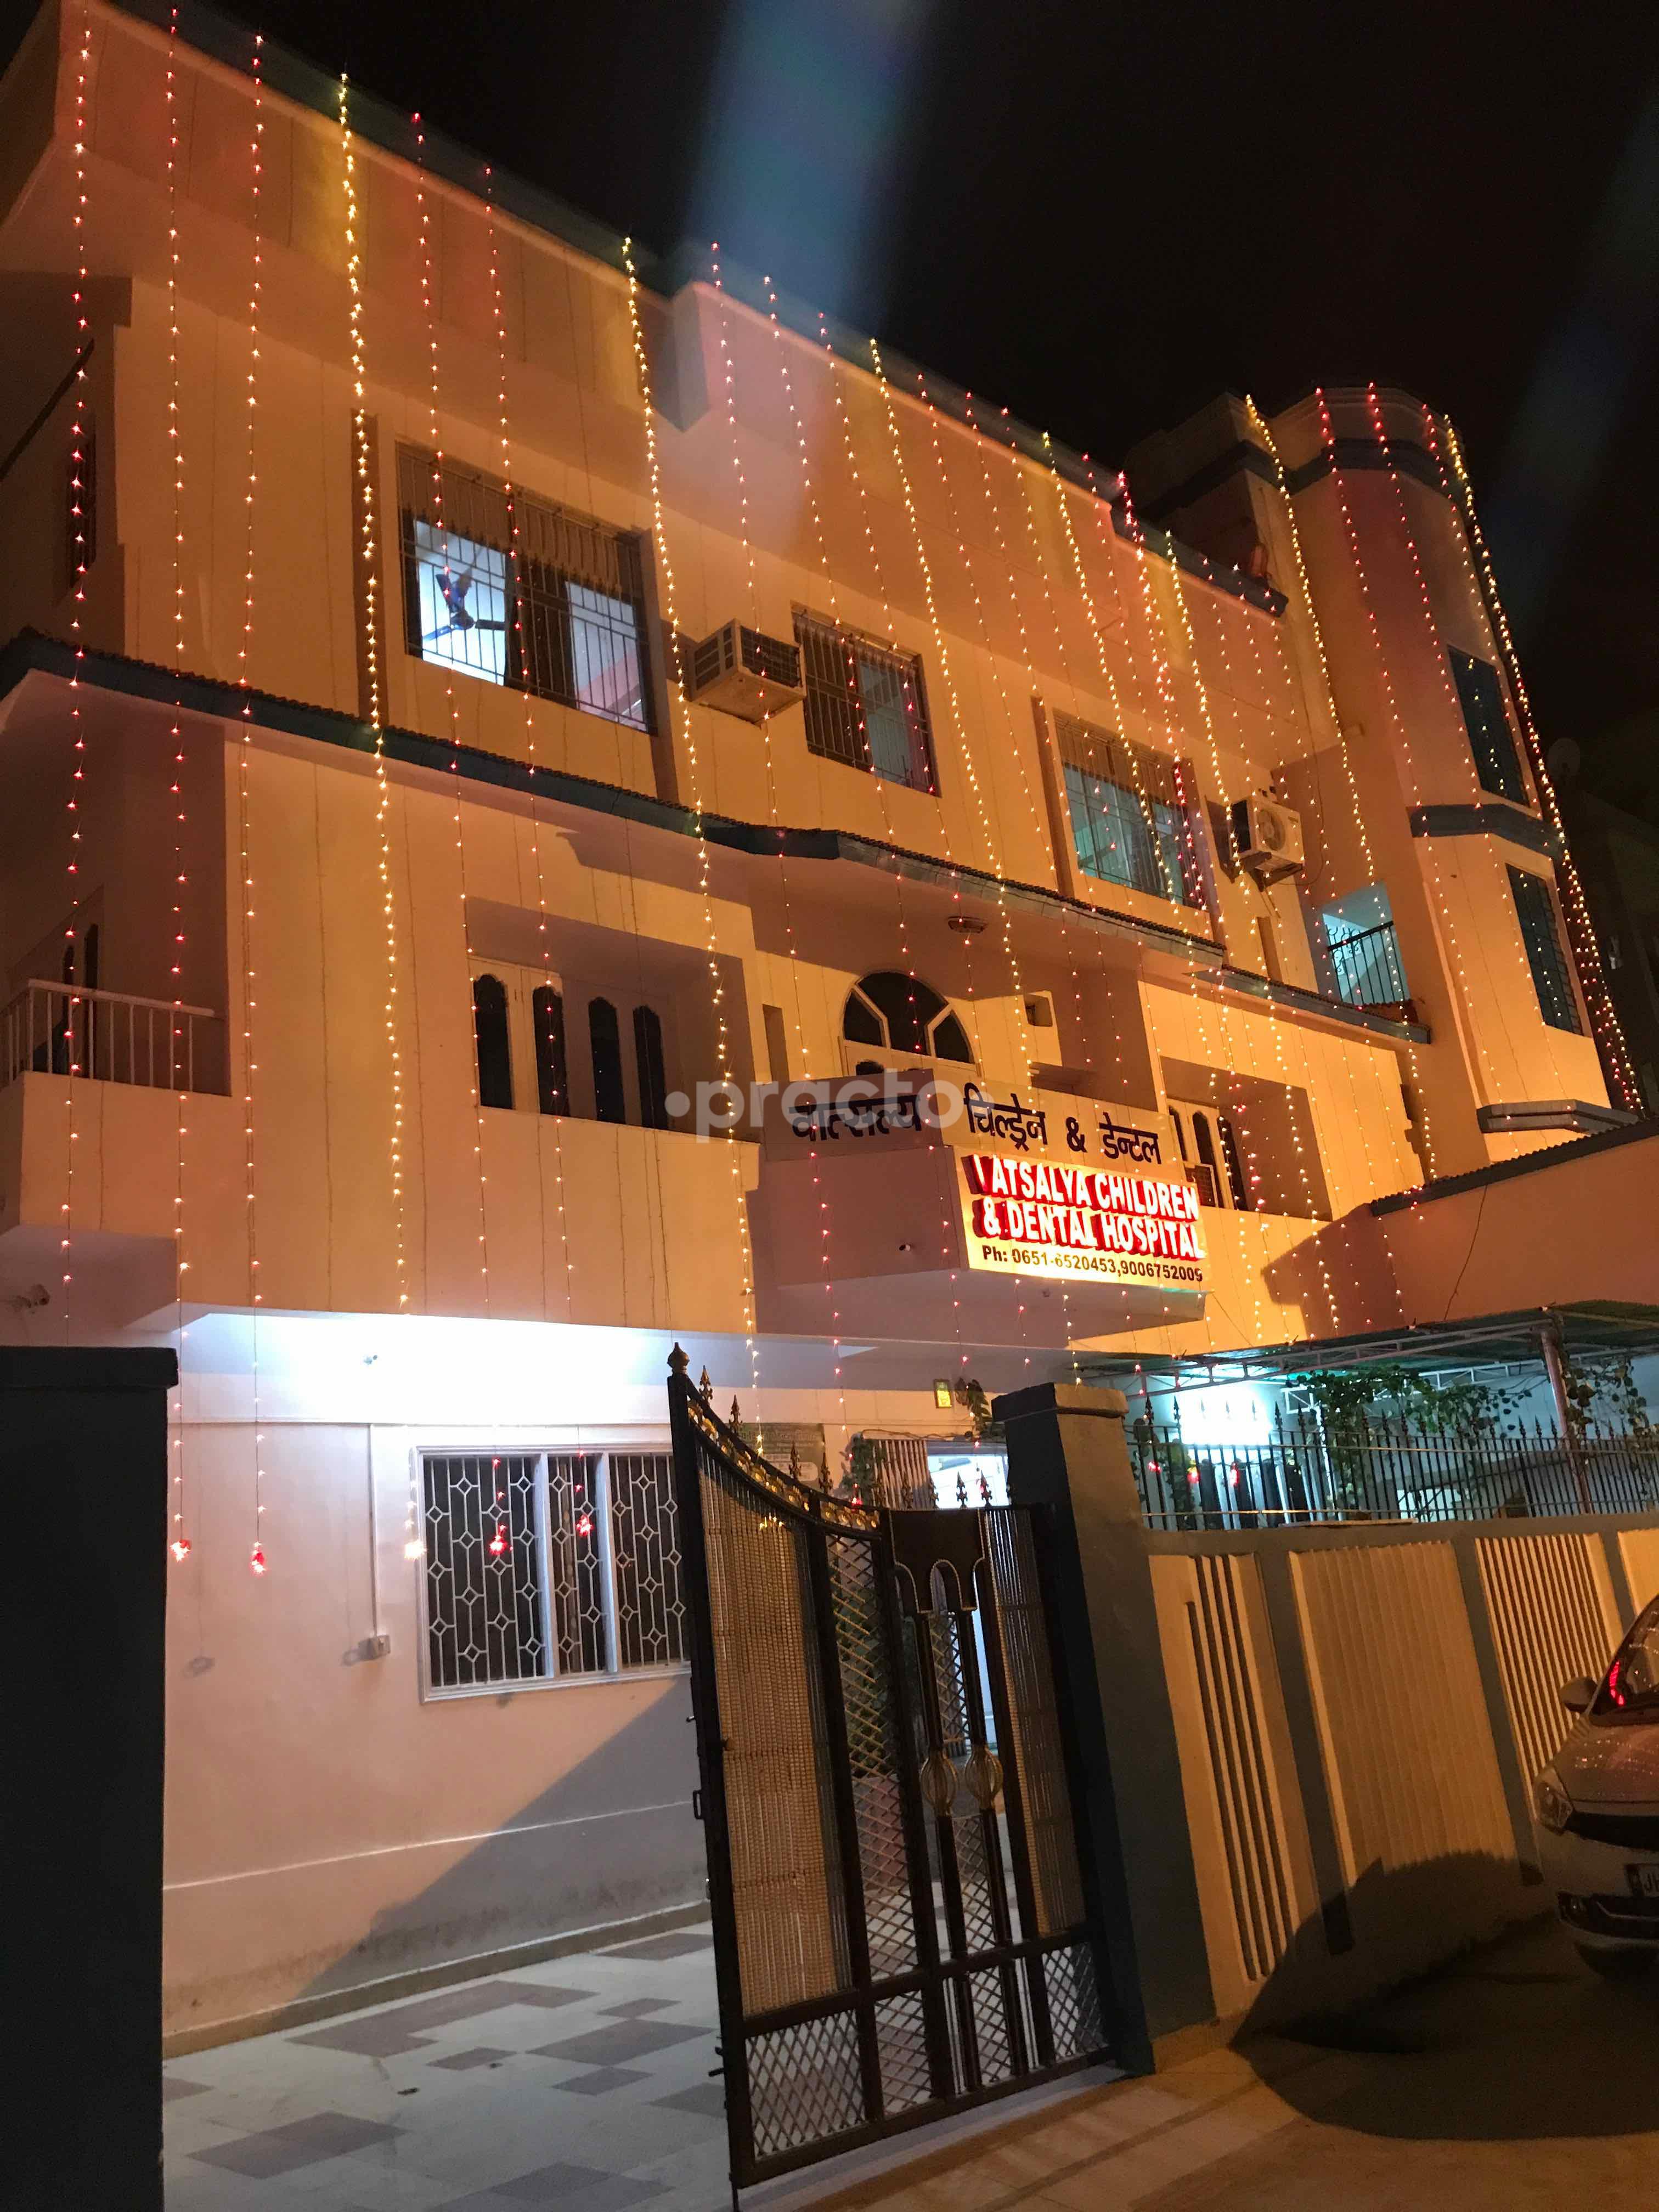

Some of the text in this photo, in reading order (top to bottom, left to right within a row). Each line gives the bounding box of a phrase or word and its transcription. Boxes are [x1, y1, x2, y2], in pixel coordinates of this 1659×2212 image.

[1065, 1116, 1087, 1153] &
[1092, 1172, 1199, 1223] CHILDREN
[982, 1196, 1208, 1261] & DENTAL HOSPITAL
[982, 1245, 1008, 1262] Ph:
